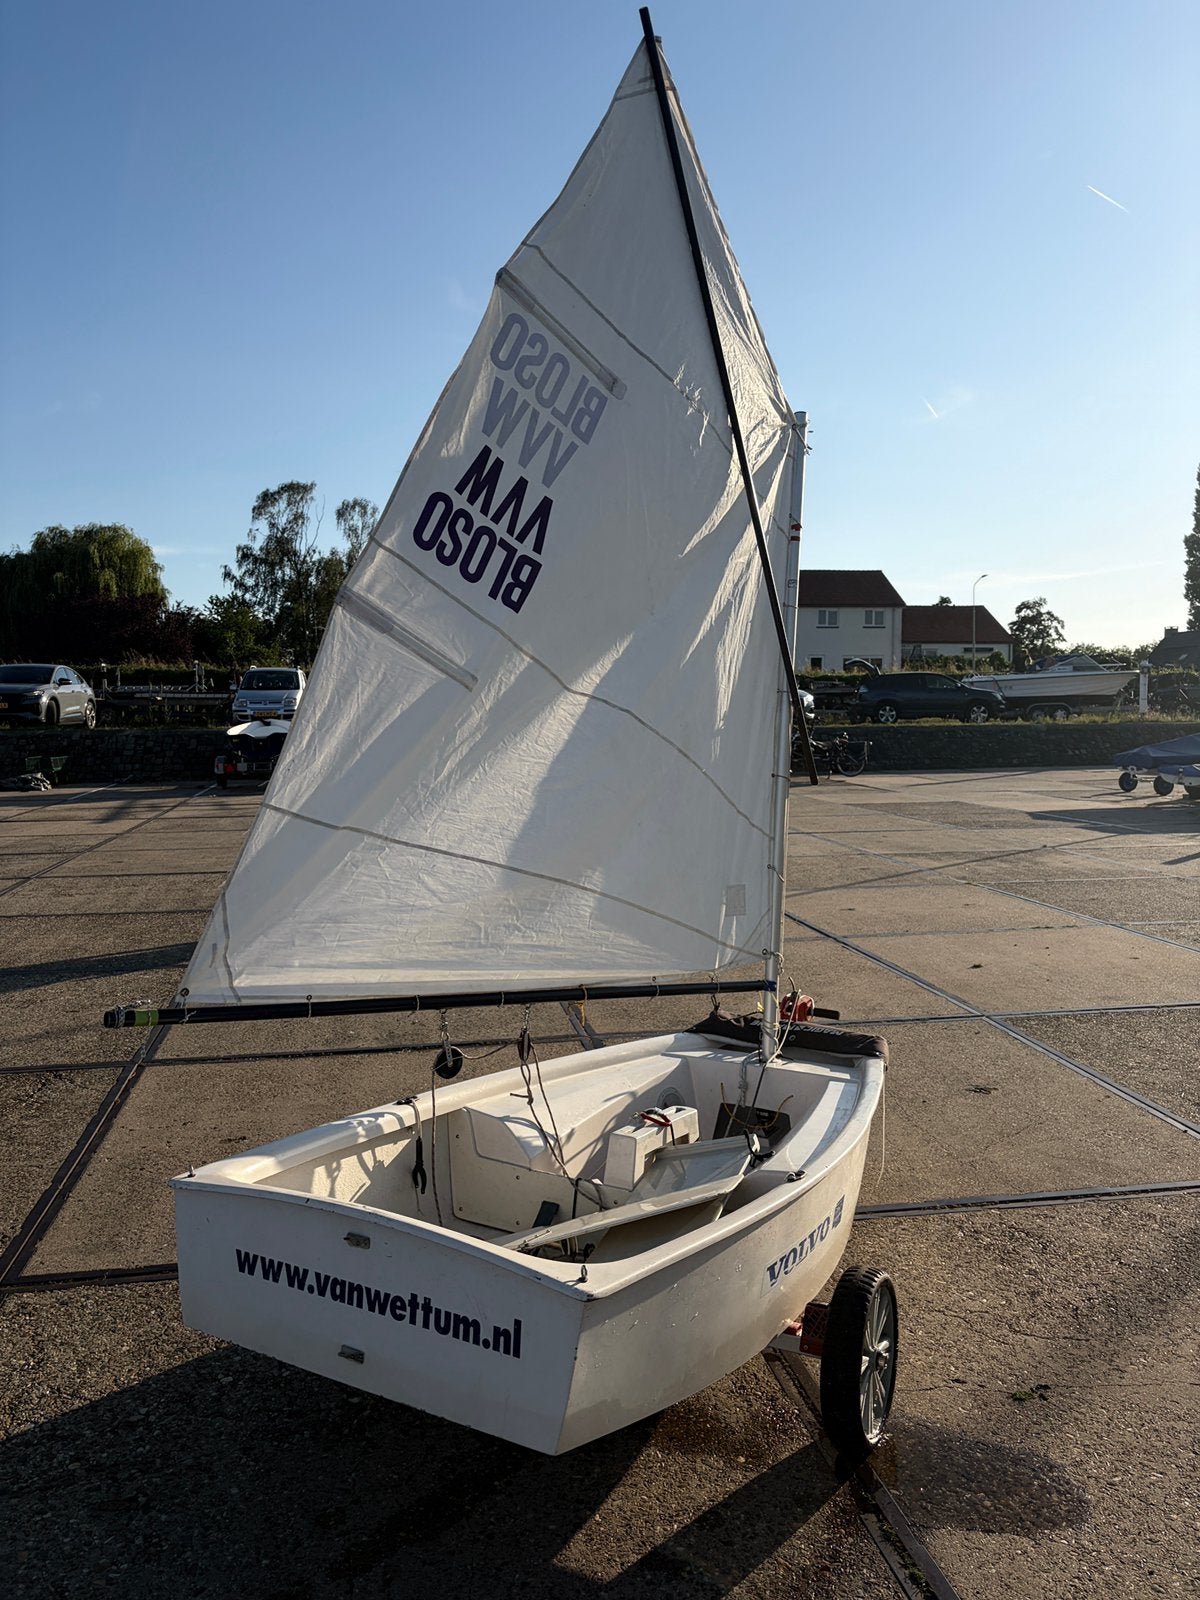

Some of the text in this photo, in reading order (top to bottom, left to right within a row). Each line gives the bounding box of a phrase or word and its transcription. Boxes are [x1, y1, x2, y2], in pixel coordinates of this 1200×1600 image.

[412, 491, 543, 614] BLOSO
[454, 444, 554, 556] VVW
[235, 1248, 522, 1359] www.vanwettum.nl
[766, 1216, 831, 1287] VOLVO
